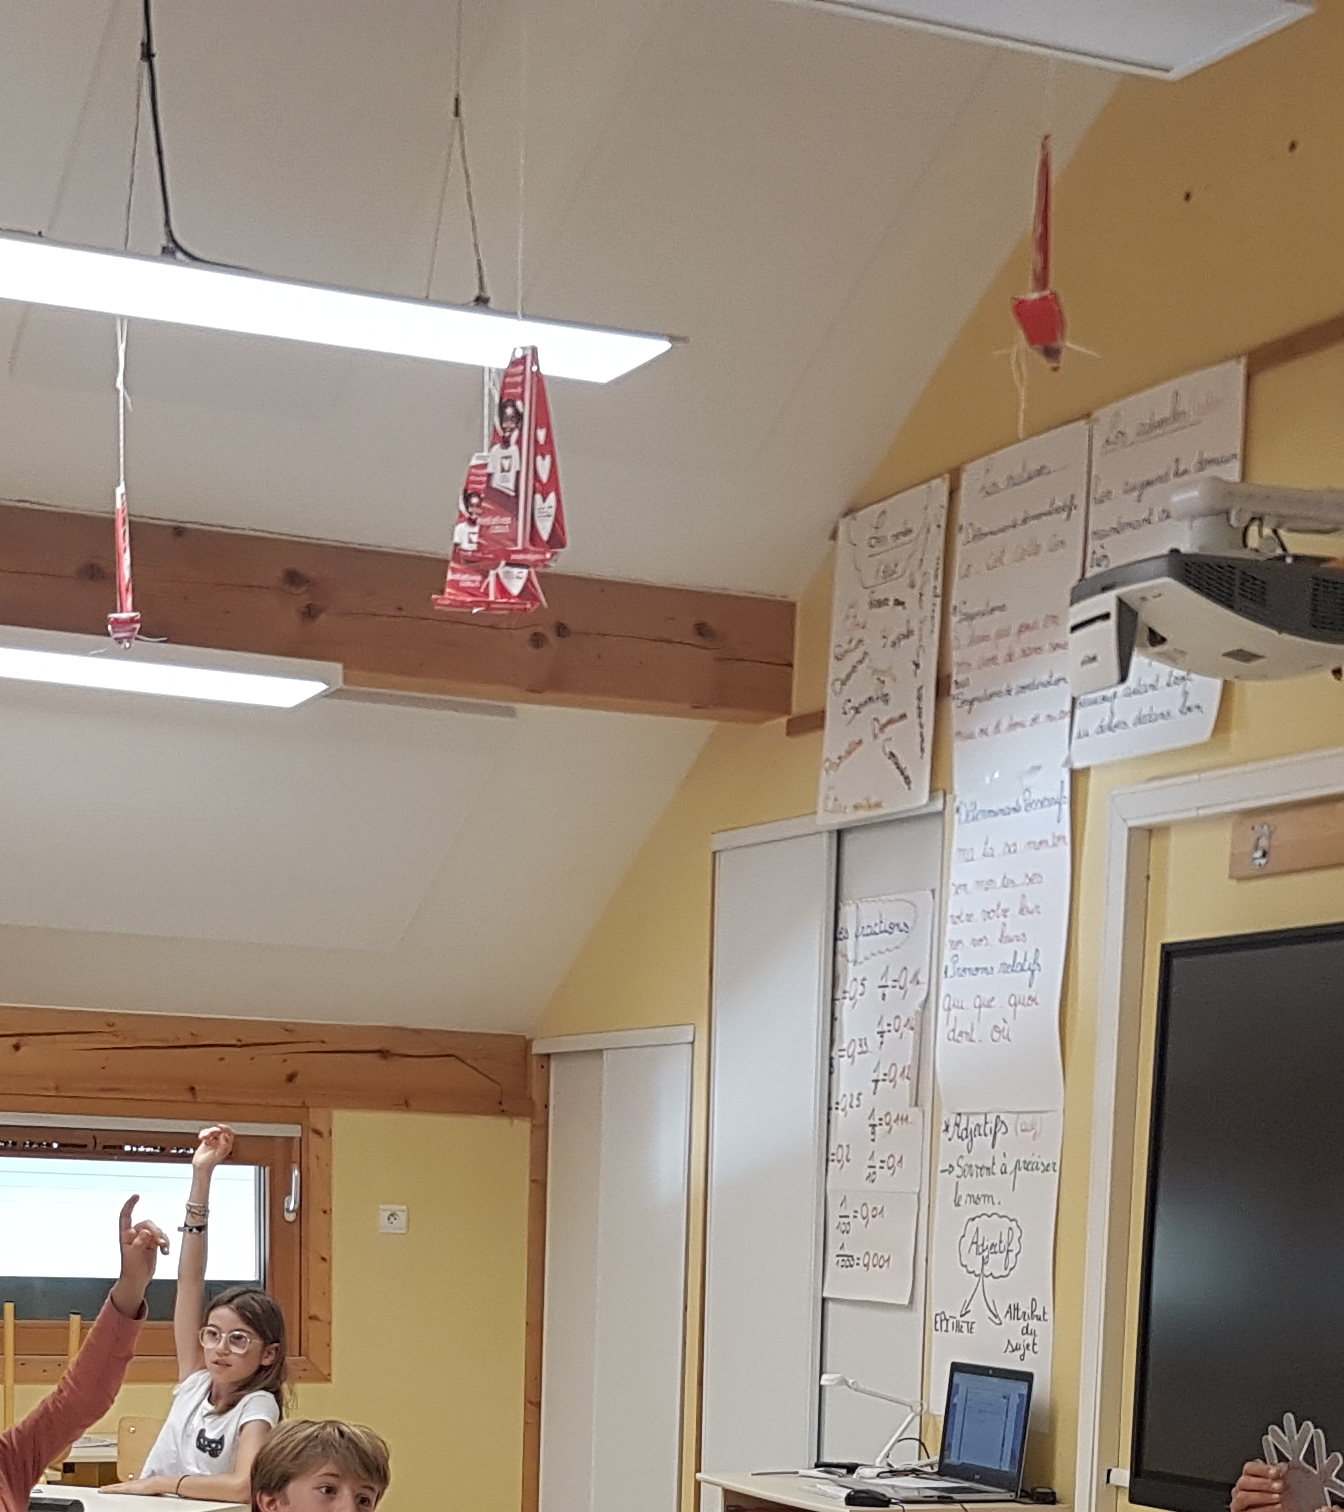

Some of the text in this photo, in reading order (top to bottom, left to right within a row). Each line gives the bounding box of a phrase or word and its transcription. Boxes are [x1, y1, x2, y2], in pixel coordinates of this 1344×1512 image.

[1007, 992, 1040, 1021] quoi
[948, 1112, 1009, 1155] Adjectifs
[868, 1150, 876, 1162] 1
[999, 1151, 1008, 1176] à
[1009, 1152, 1058, 1192] préciser
[840, 1194, 847, 1210] 1
[952, 1180, 963, 1207] le
[839, 1241, 845, 1251] 1
[968, 1226, 1015, 1271] Adjectif
[1003, 1296, 1049, 1323] Attribut
[1021, 1322, 1039, 1337] du
[1003, 1338, 1039, 1362] sujet
